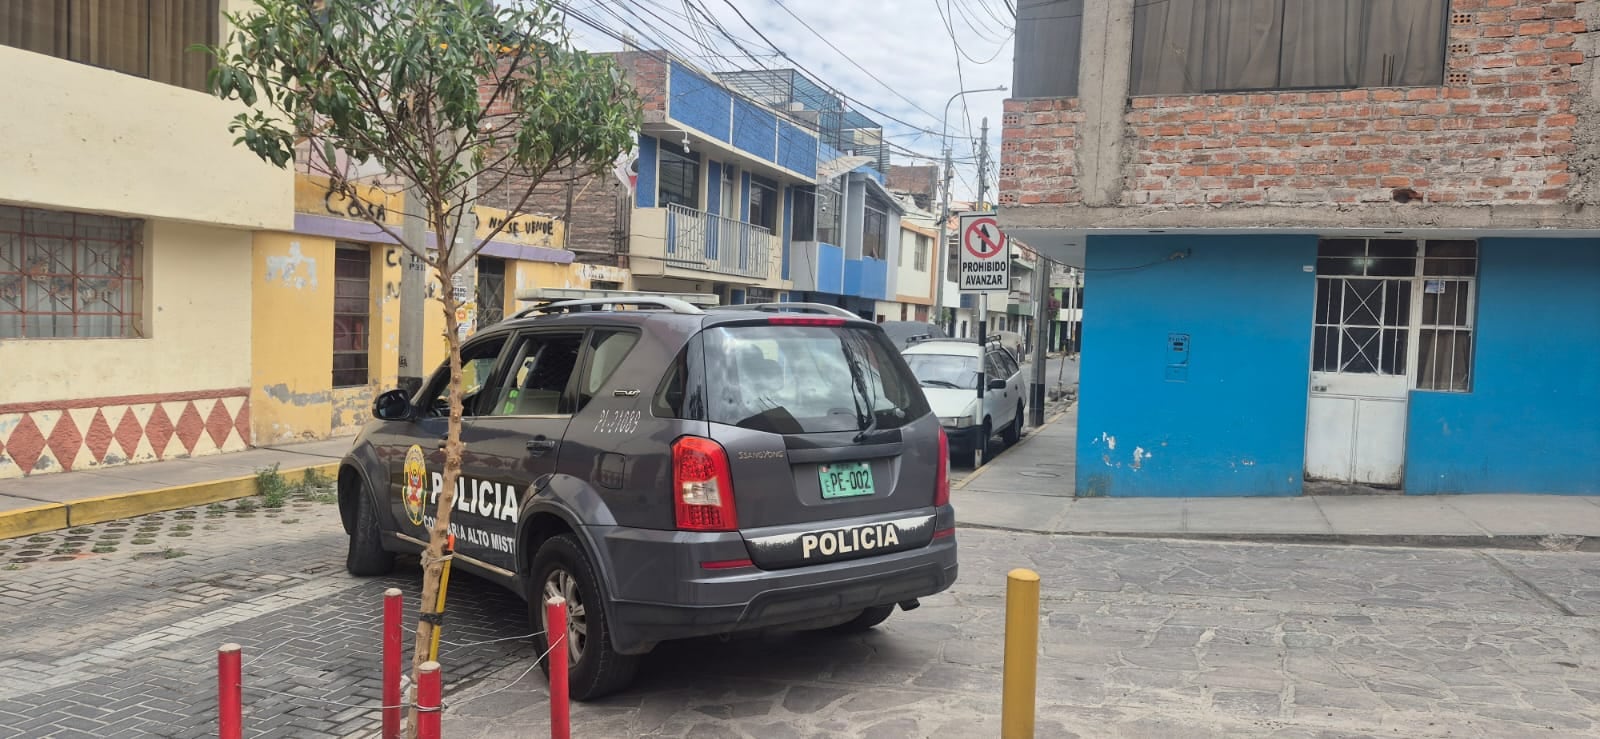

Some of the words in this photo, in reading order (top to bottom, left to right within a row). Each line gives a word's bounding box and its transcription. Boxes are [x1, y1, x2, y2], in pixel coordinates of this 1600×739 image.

[507, 221, 519, 236] SE
[962, 261, 1006, 273] PROHIBIDO
[966, 274, 1003, 286] AVANZAR
[830, 470, 872, 491] PE-002
[423, 515, 466, 541] COARIA
[467, 527, 490, 548] ALTO
[802, 524, 899, 559] POLICIA
